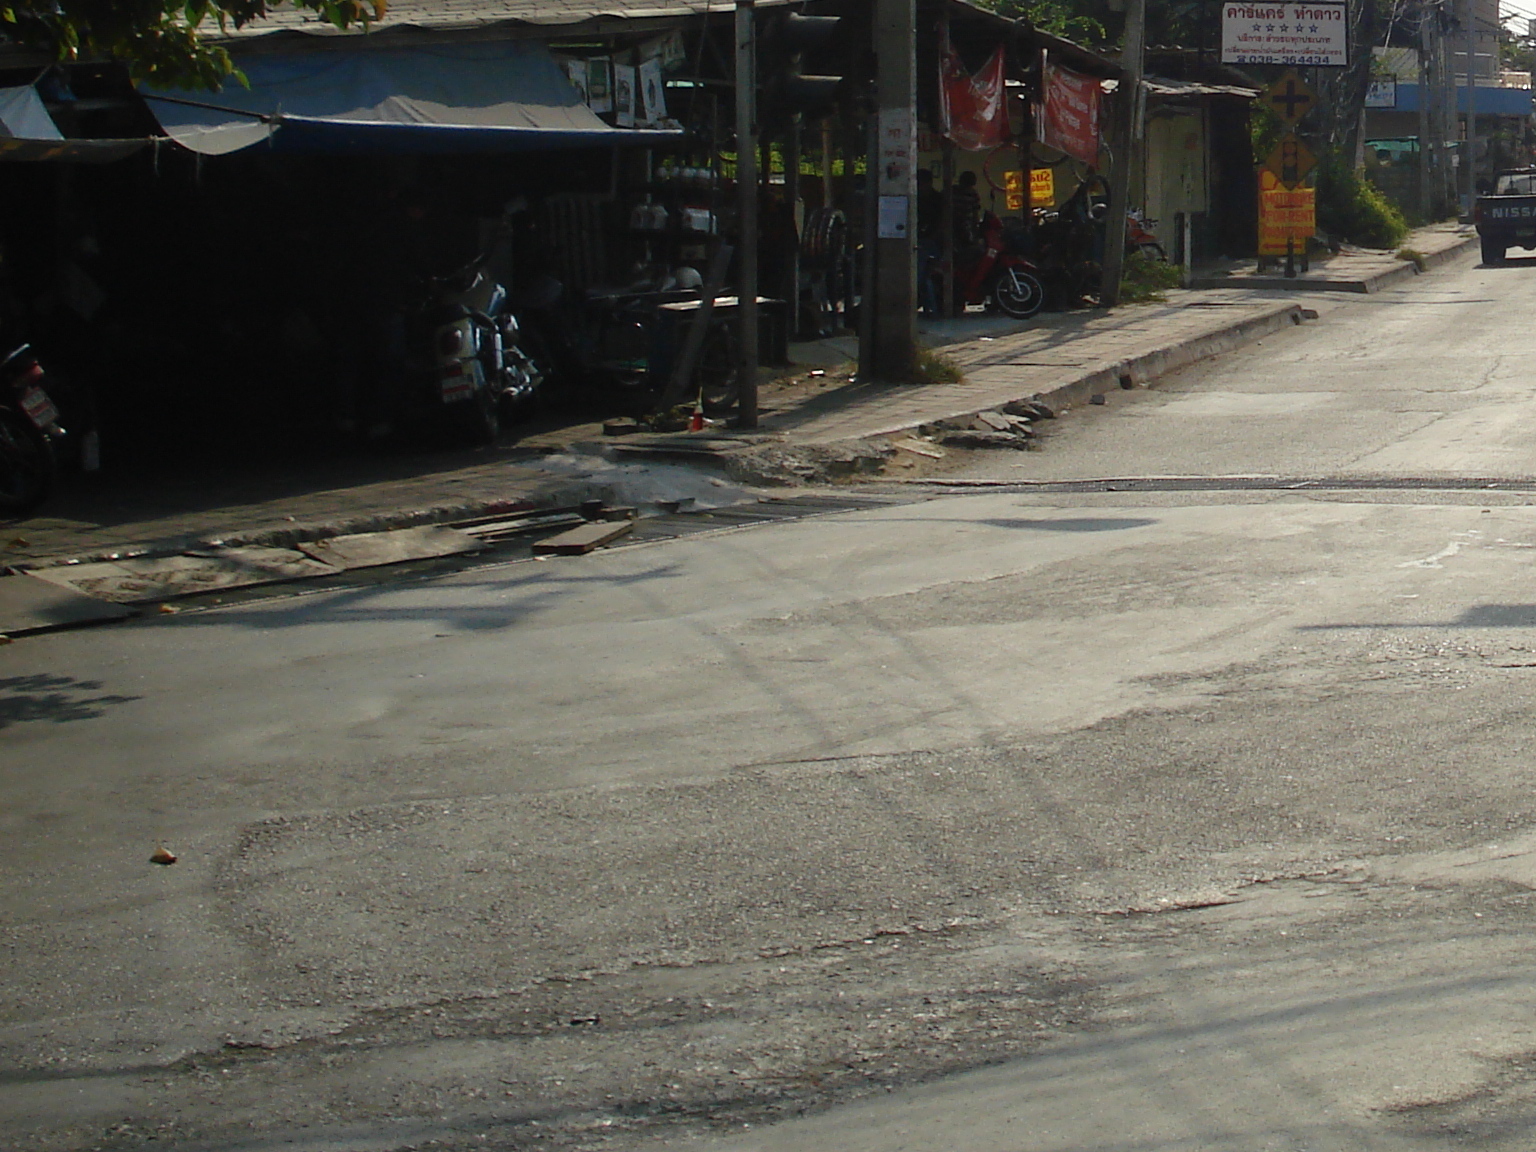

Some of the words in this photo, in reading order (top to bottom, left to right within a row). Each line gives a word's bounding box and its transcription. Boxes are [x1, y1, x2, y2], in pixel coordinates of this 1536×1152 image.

[1227, 3, 1285, 20] คาร์แคร์
[1294, 5, 1342, 21] ห้าดาว
